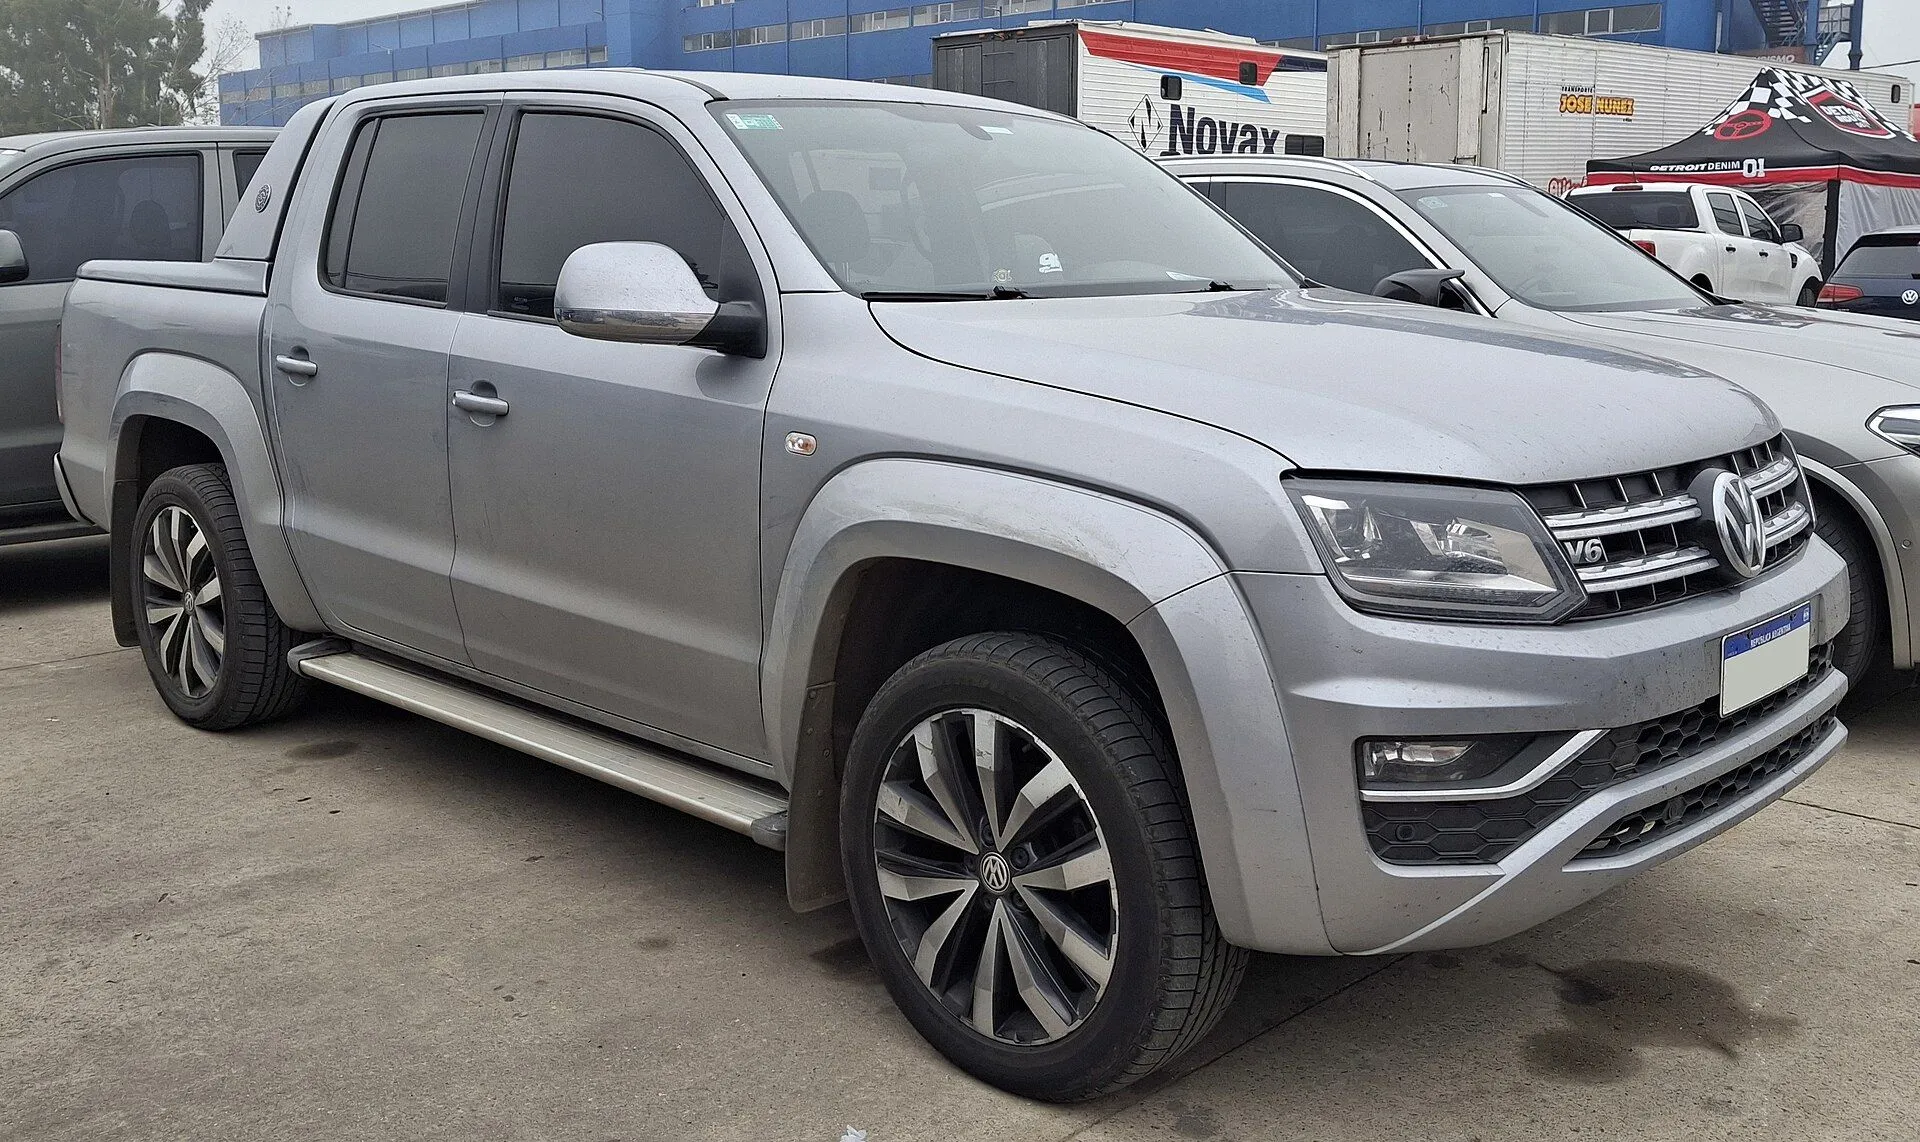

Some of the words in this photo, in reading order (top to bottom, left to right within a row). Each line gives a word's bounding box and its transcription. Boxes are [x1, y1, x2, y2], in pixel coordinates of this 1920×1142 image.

[1559, 94, 1593, 114] JOSE
[1168, 103, 1280, 155] Novax
[1650, 163, 1707, 171] DETROIT
[1707, 160, 1740, 170] DENIM
[1742, 158, 1766, 178] 01
[1563, 538, 1602, 564] V6
